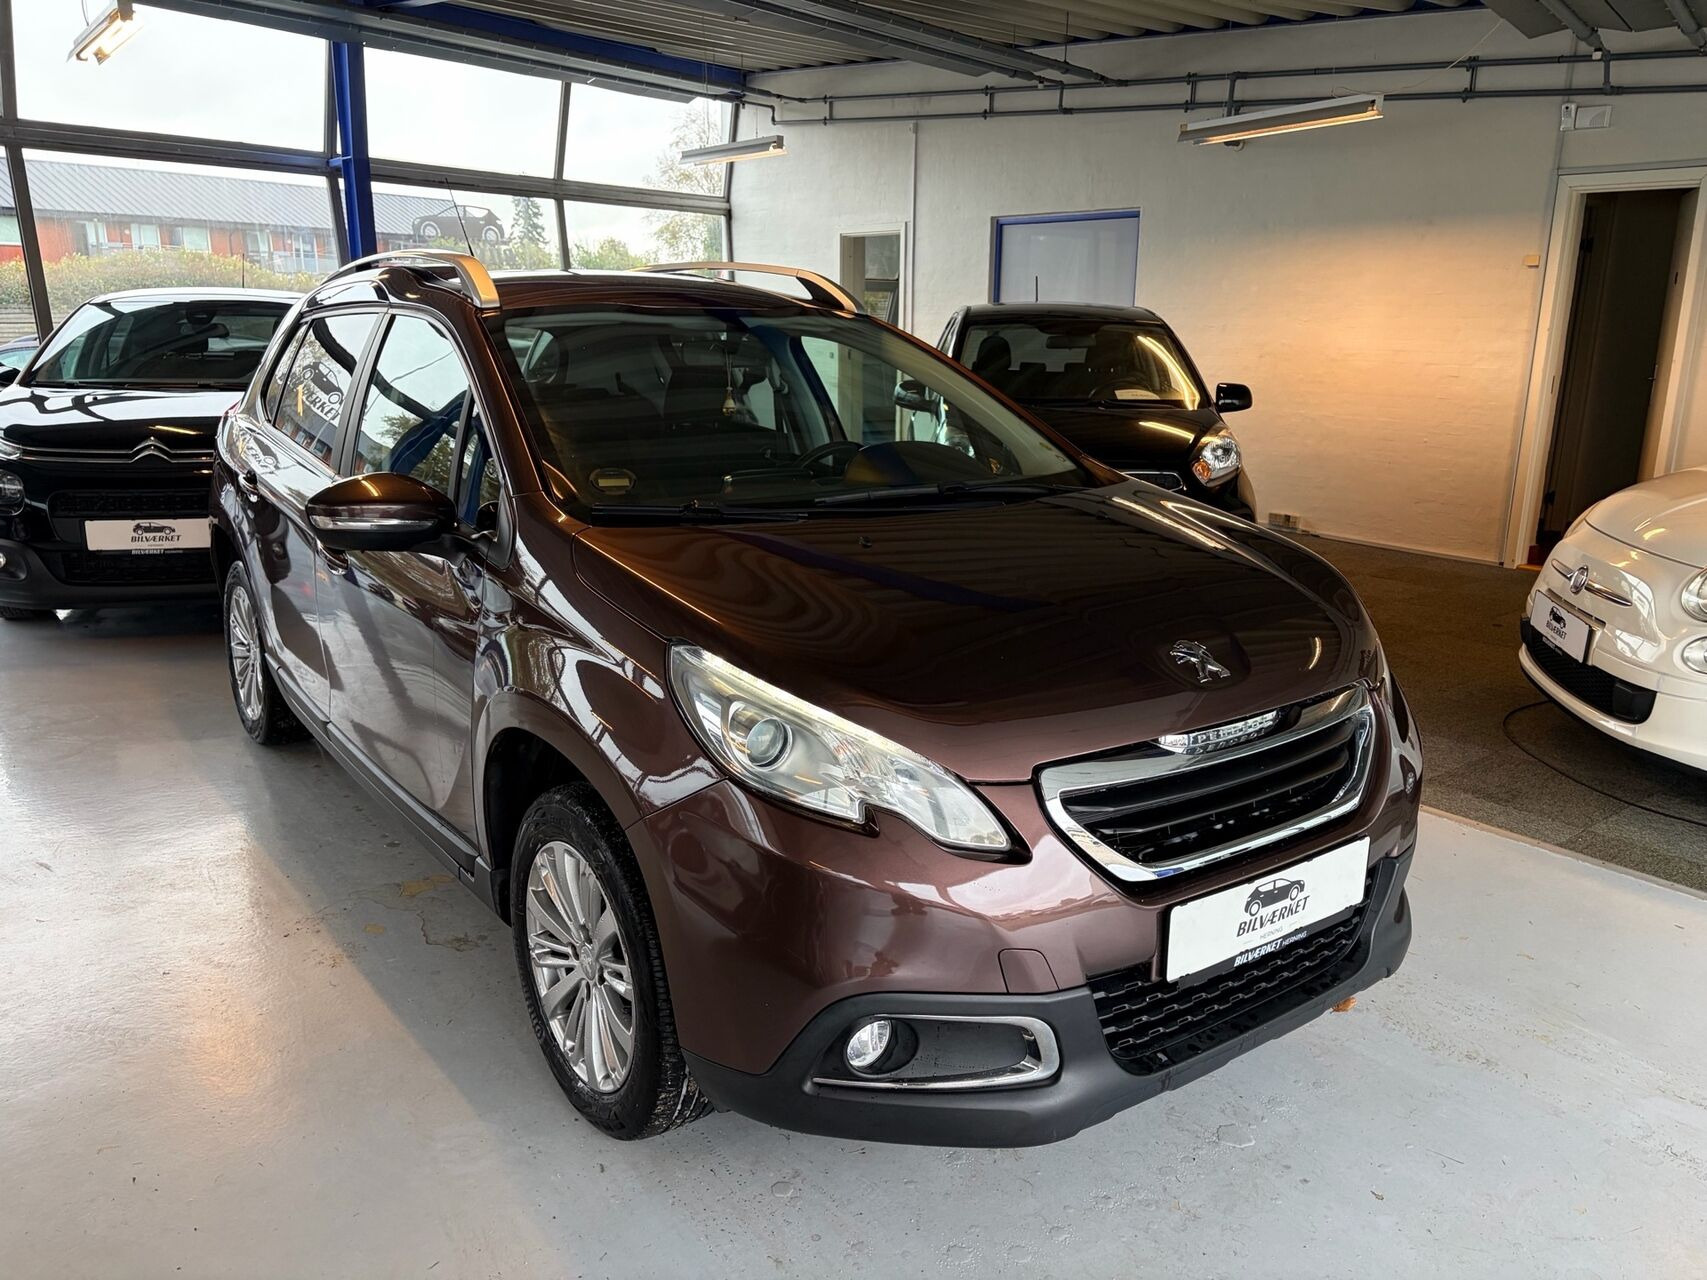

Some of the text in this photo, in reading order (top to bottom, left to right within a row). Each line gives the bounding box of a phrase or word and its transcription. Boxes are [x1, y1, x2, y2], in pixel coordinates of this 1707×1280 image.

[130, 534, 182, 543] BILVÆRKET
[1236, 895, 1311, 938] BILVÆRKET
[1233, 930, 1308, 968] BILVÆRKET HERNING
